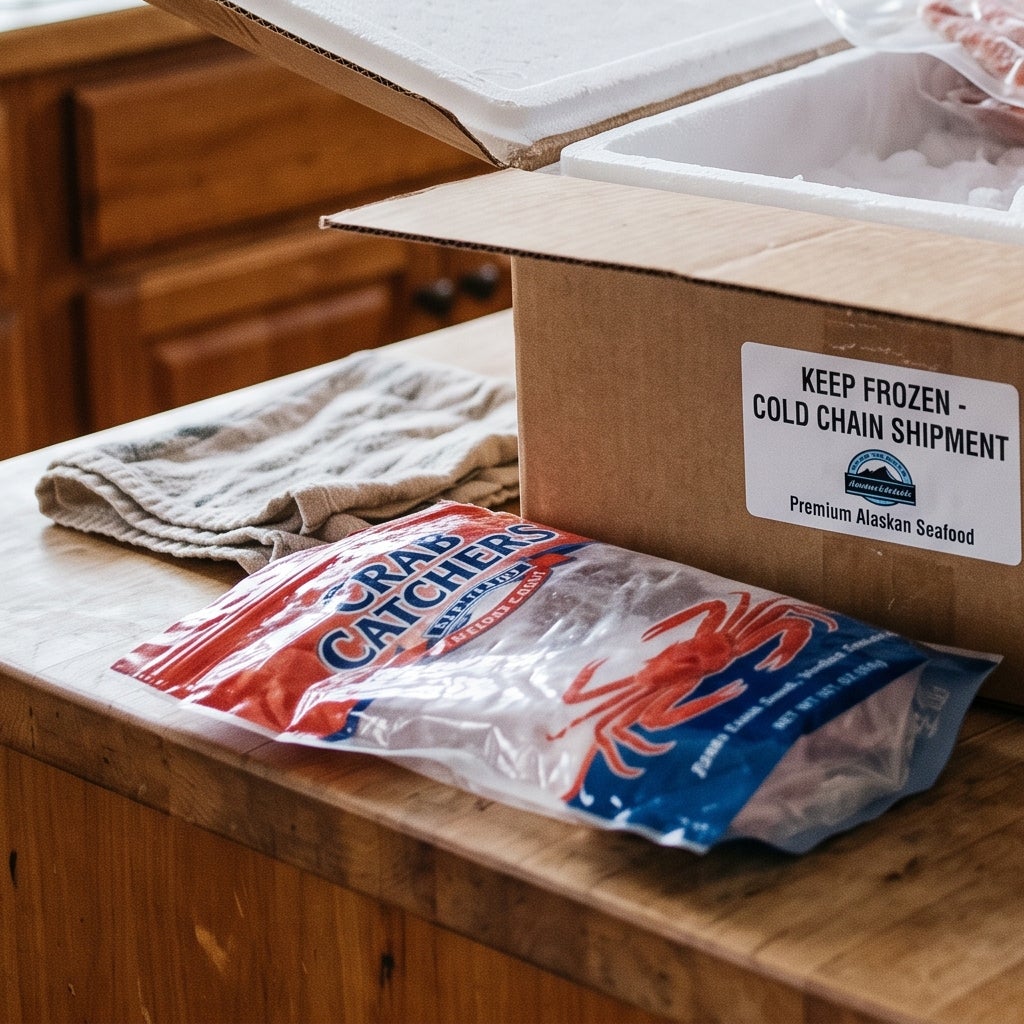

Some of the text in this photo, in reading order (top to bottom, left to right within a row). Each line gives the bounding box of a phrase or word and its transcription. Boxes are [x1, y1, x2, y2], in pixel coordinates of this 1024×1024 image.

[801, 366, 856, 399] KEEP
[864, 377, 950, 416] FROZEN
[753, 393, 1009, 462] COLD CHAIN SHIPMENT
[790, 495, 975, 546] Premium Alaskan Seafood
[321, 524, 557, 670] CATCHERS
[323, 533, 464, 613] CRAB
